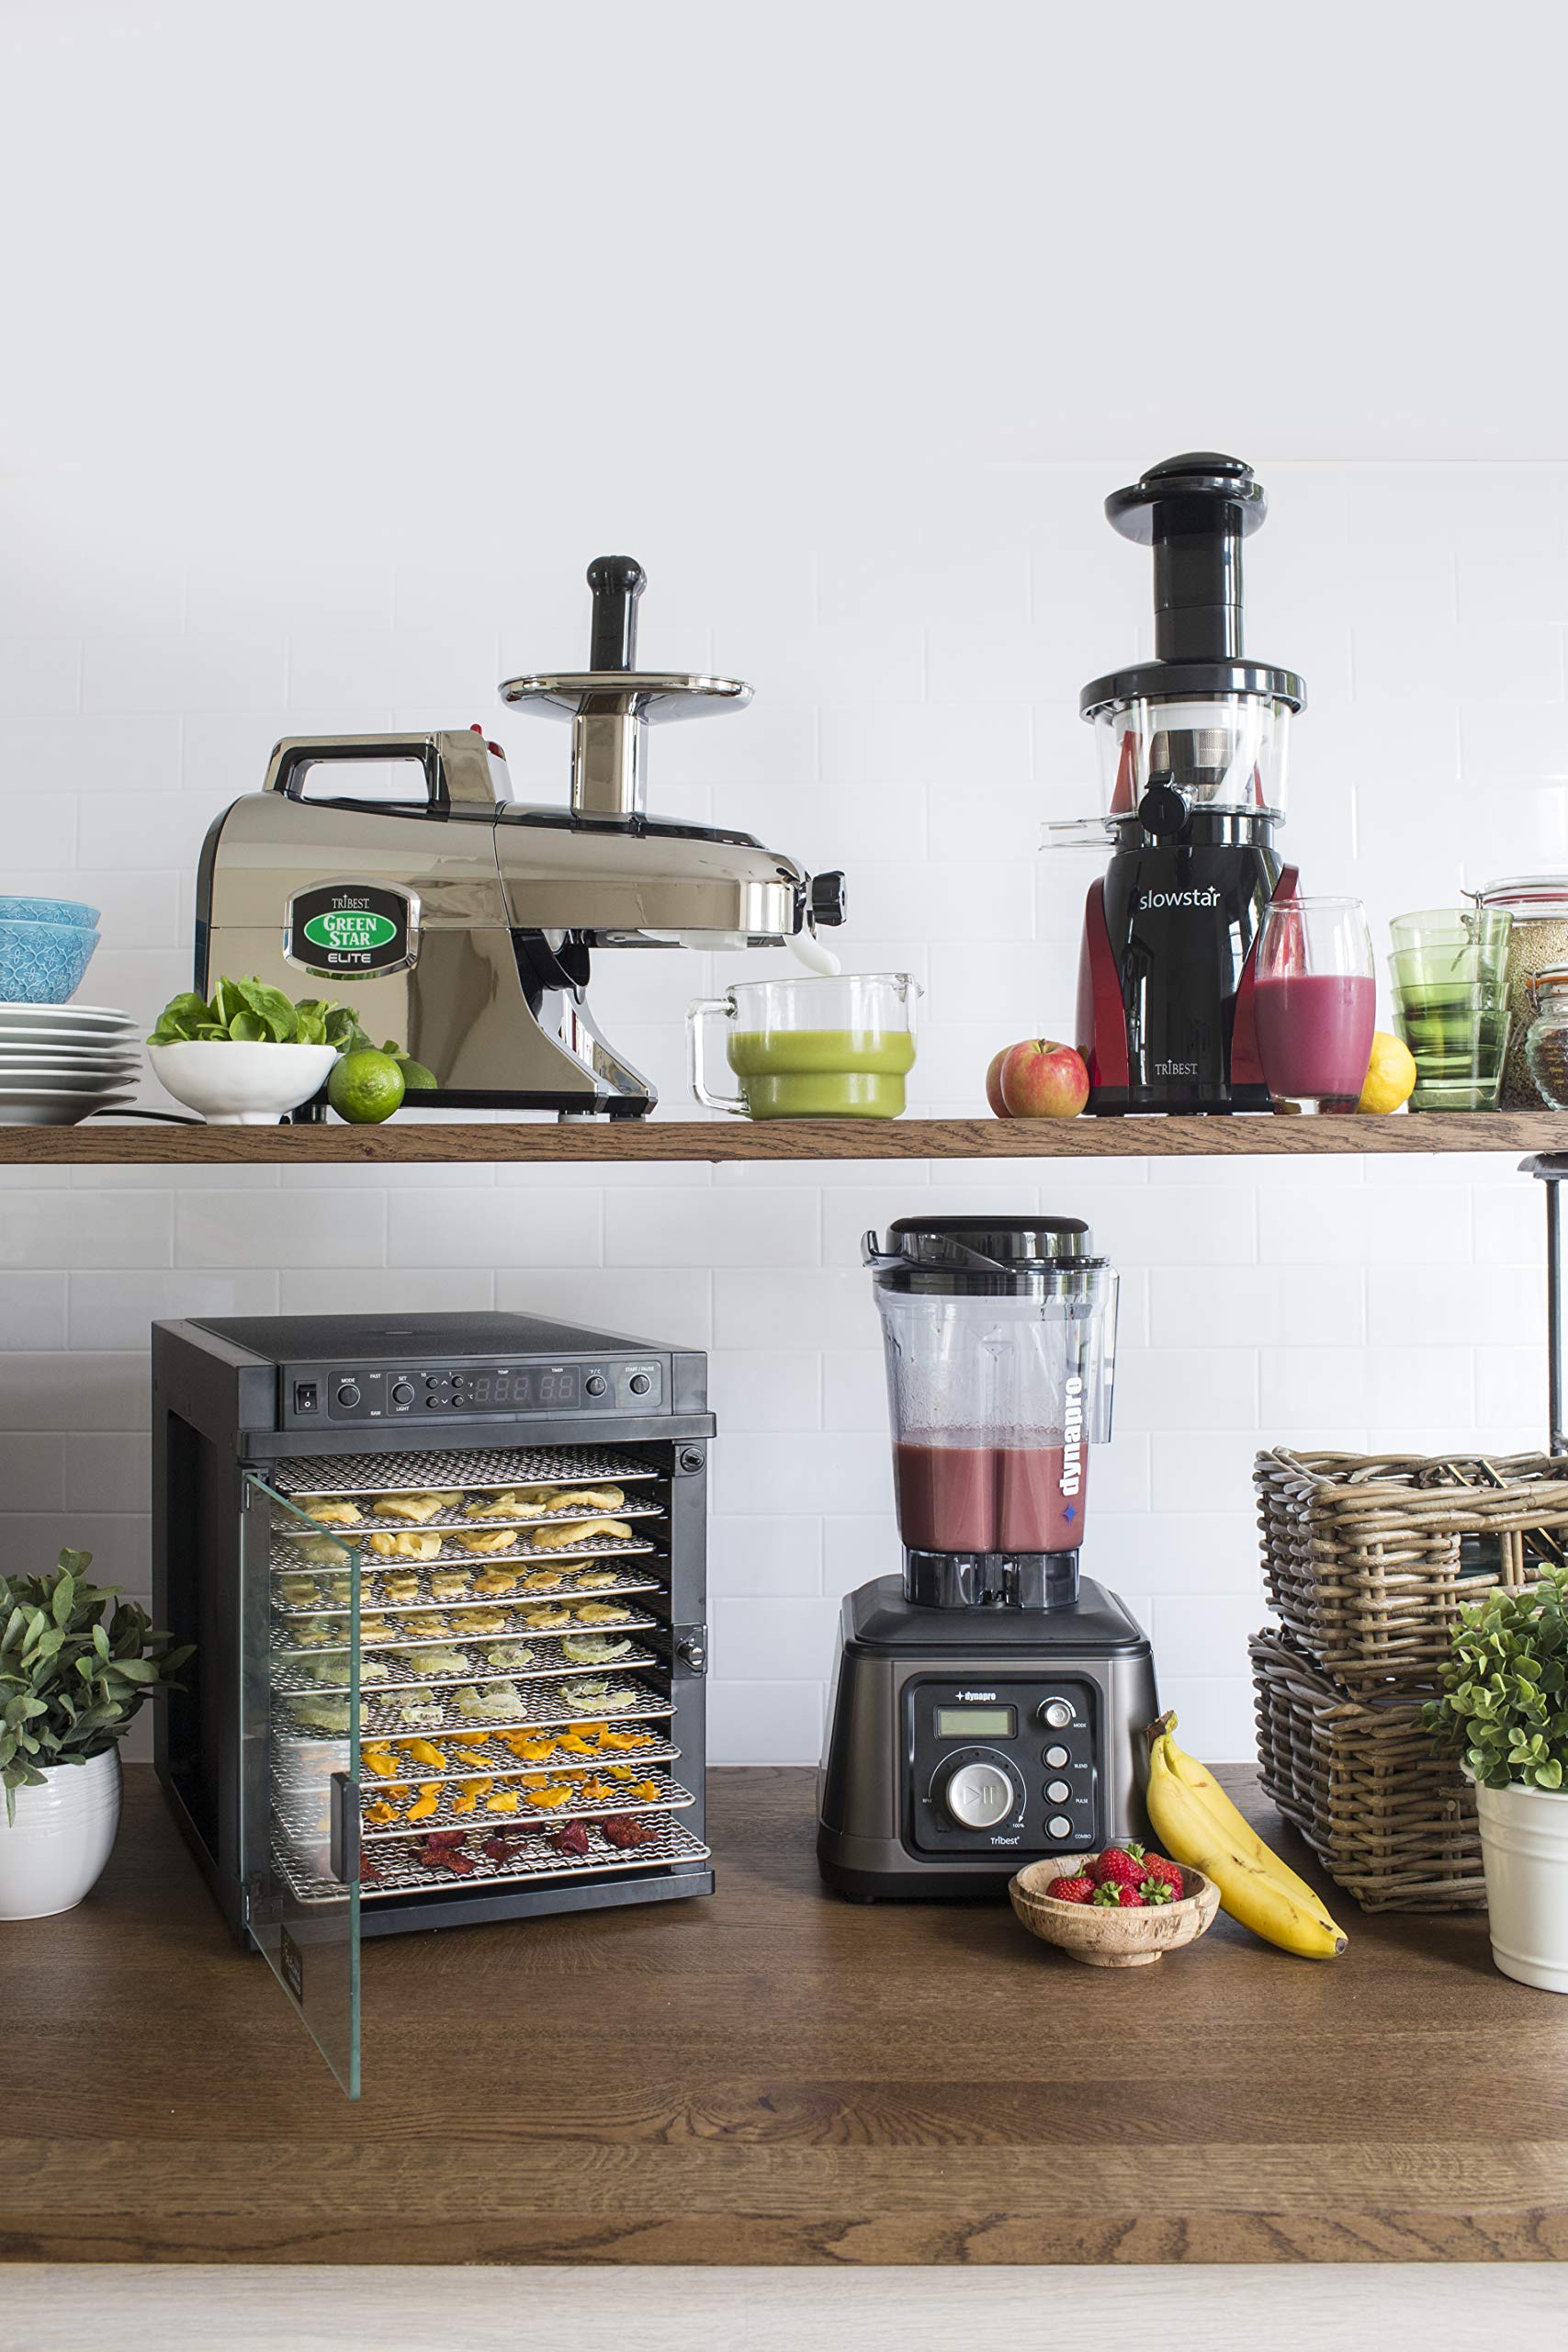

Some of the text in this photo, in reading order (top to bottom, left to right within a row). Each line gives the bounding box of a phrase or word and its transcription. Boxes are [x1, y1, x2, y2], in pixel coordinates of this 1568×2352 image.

[332, 894, 369, 909] TRIBEST
[1139, 886, 1221, 910] slowstar
[323, 914, 378, 932] GREEN
[329, 931, 371, 947] STAR
[328, 953, 371, 964] ELITE
[1155, 1059, 1198, 1075] TRIBEST
[1059, 1376, 1082, 1497] dynapro
[964, 1691, 997, 1702] dynapro
